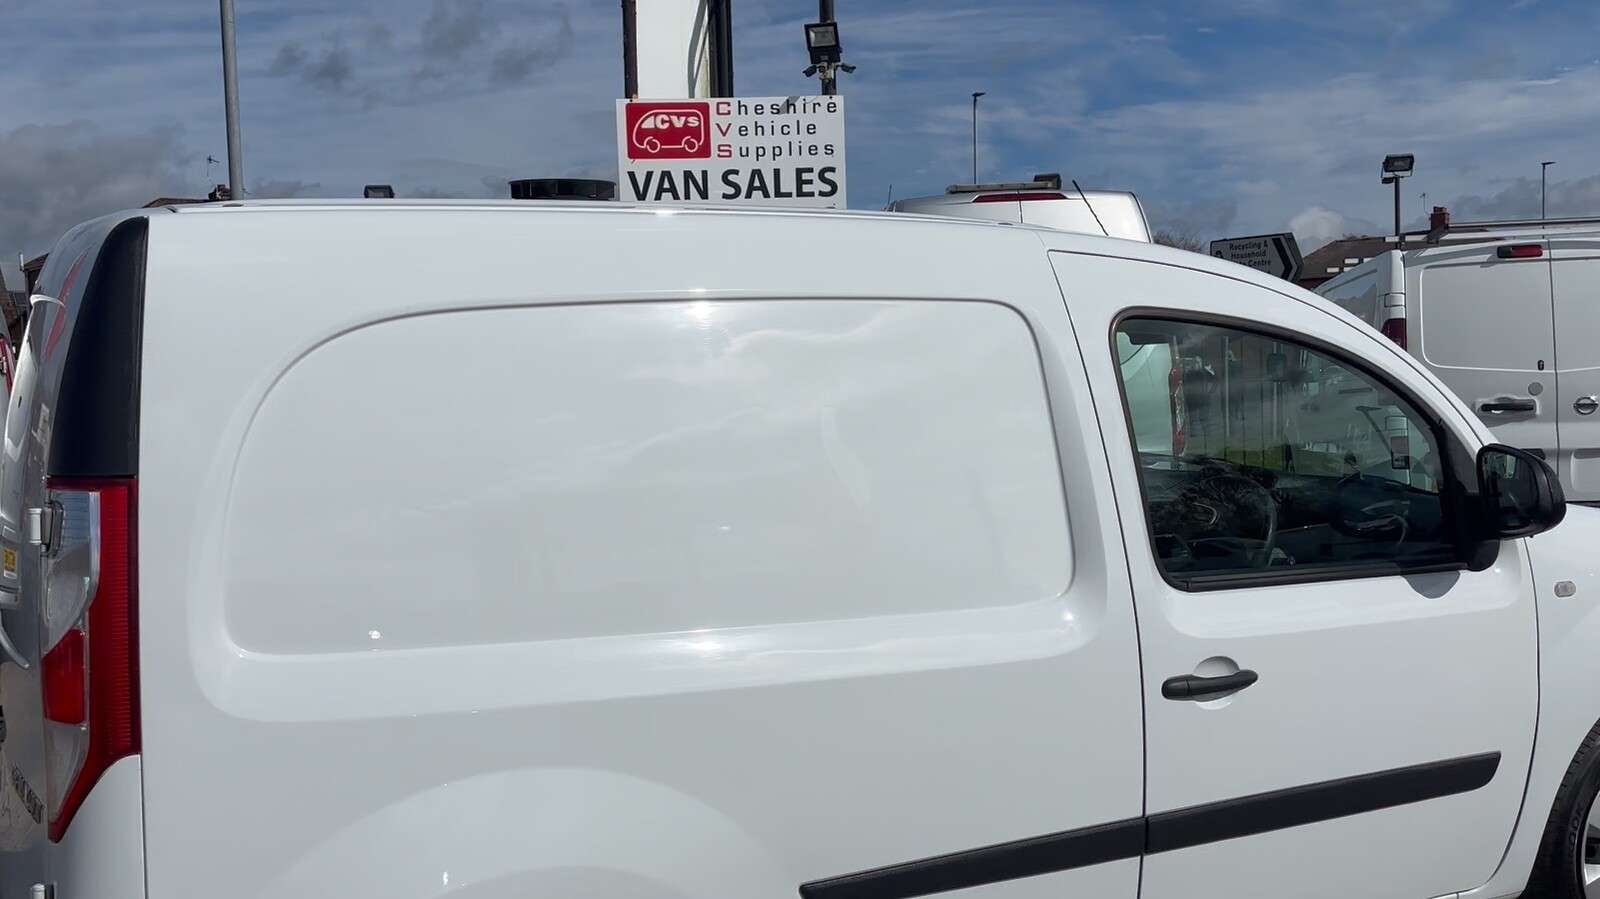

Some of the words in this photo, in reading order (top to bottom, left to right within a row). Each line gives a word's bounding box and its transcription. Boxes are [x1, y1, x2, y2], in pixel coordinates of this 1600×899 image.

[716, 98, 837, 115] Cheshire
[716, 120, 817, 137] Vehicle
[717, 141, 835, 161] Supplies
[627, 170, 709, 201] VAN
[721, 166, 839, 200] SALES
